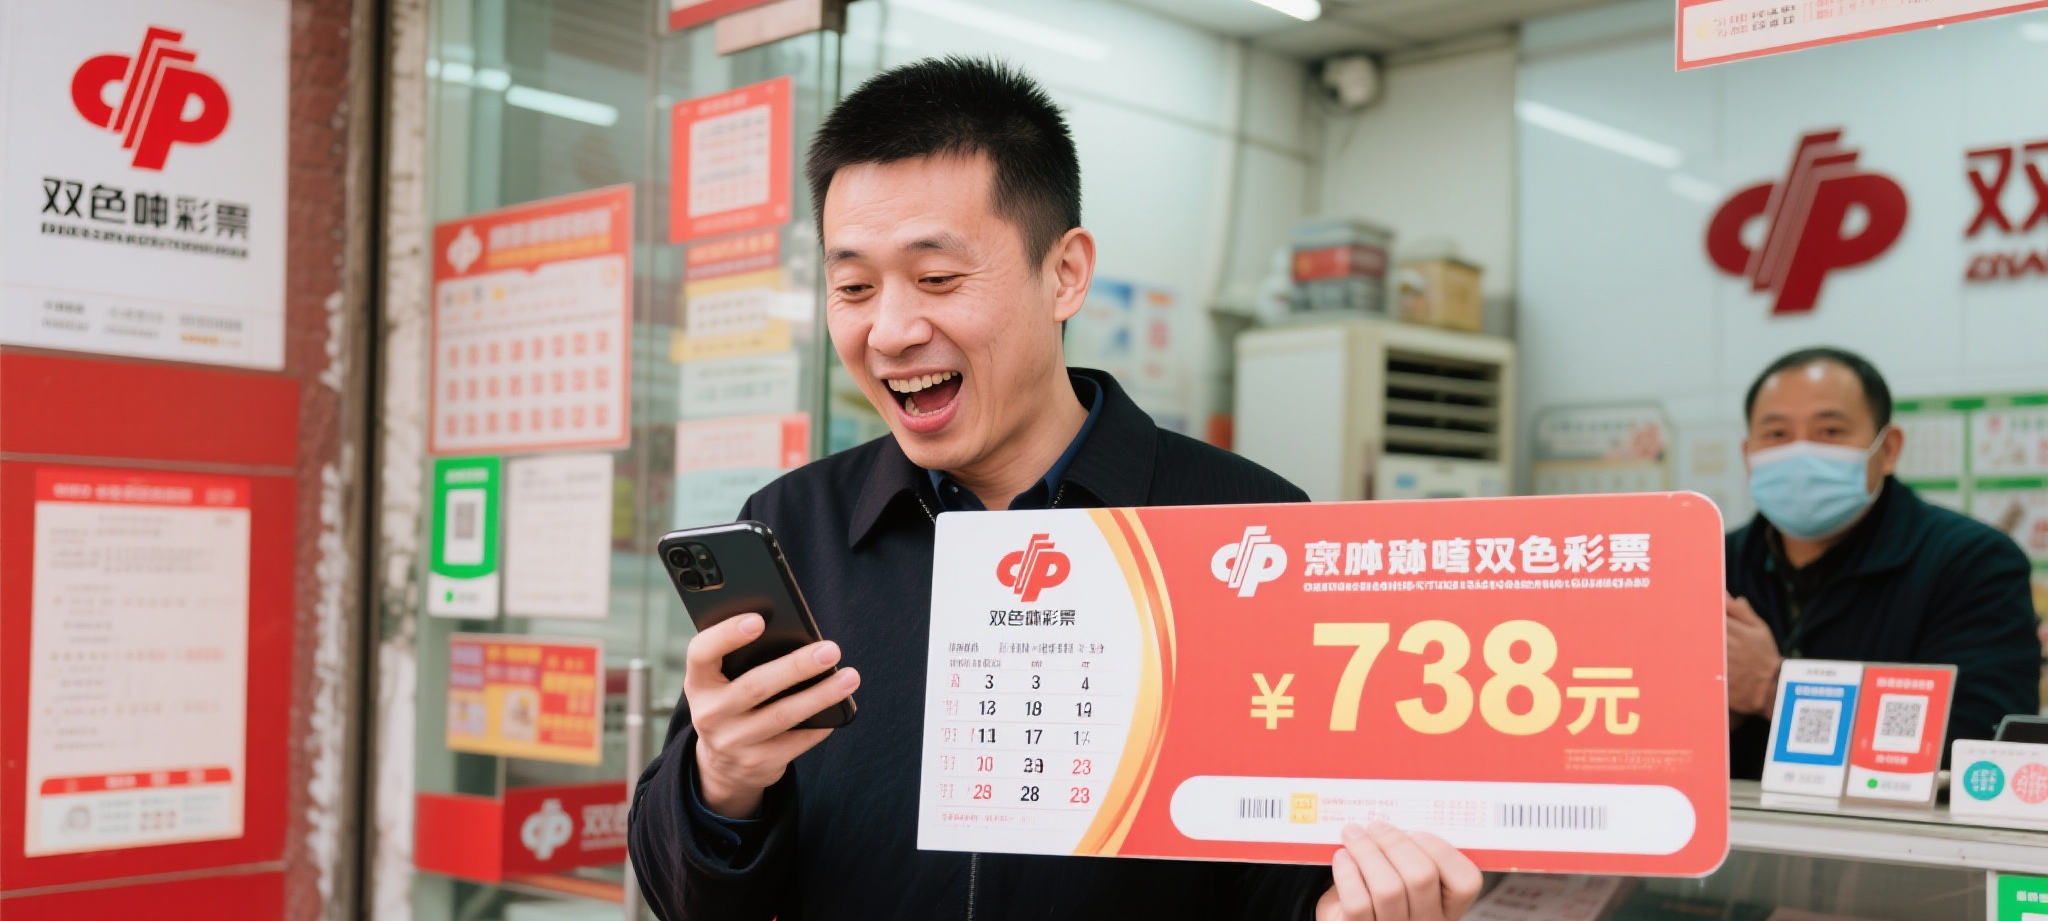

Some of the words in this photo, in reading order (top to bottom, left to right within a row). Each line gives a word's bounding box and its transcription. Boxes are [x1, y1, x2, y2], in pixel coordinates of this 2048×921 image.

[1032, 675, 1041, 689] 3
[1025, 729, 1043, 744] 17
[1020, 786, 1039, 801] 28
